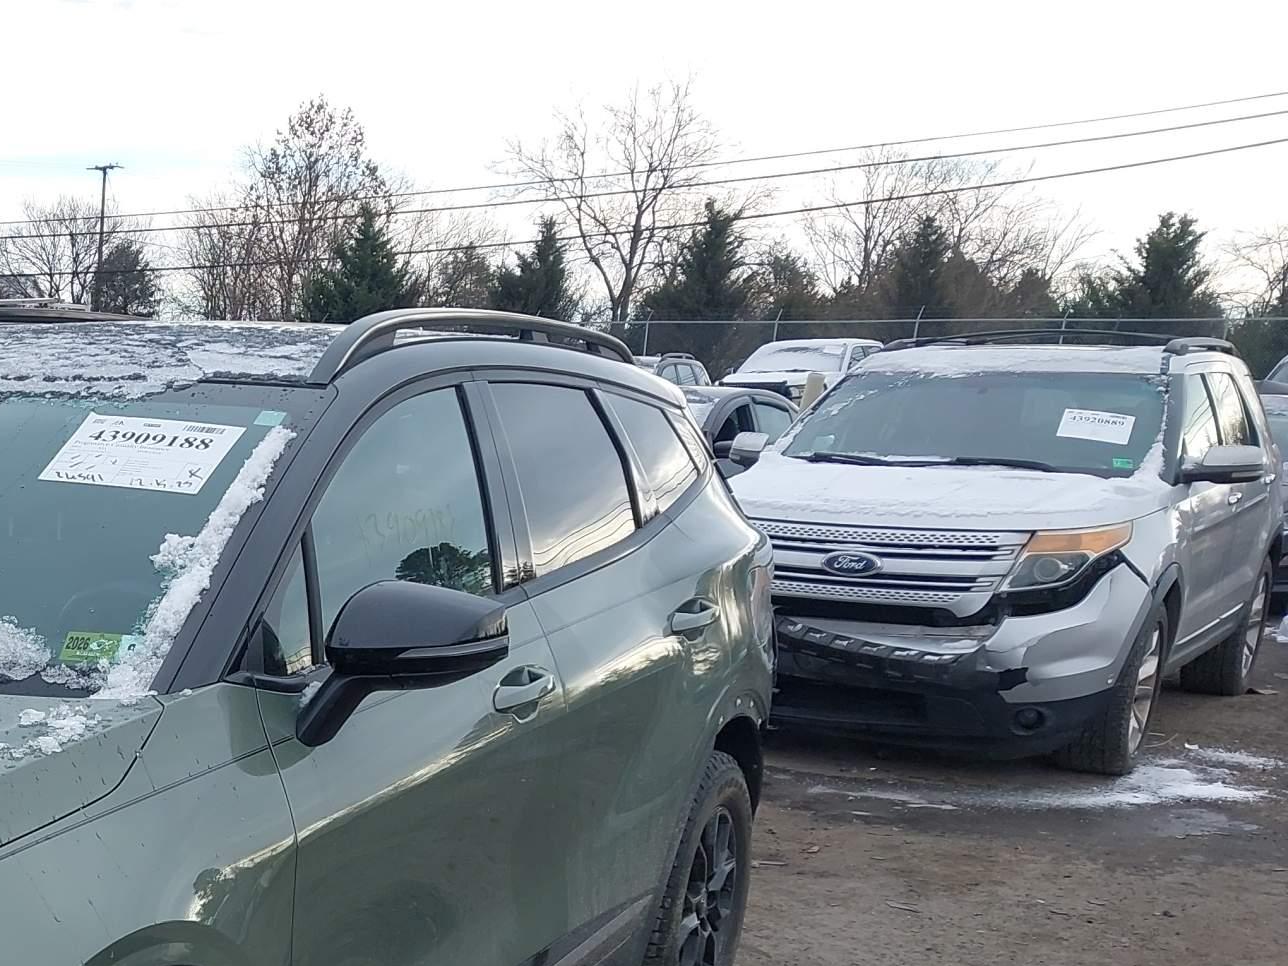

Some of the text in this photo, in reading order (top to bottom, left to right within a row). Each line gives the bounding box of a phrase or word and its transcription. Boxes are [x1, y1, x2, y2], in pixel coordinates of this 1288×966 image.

[88, 429, 214, 451] 43909188
[833, 555, 868, 570] Ford
[64, 636, 91, 651] 2026
